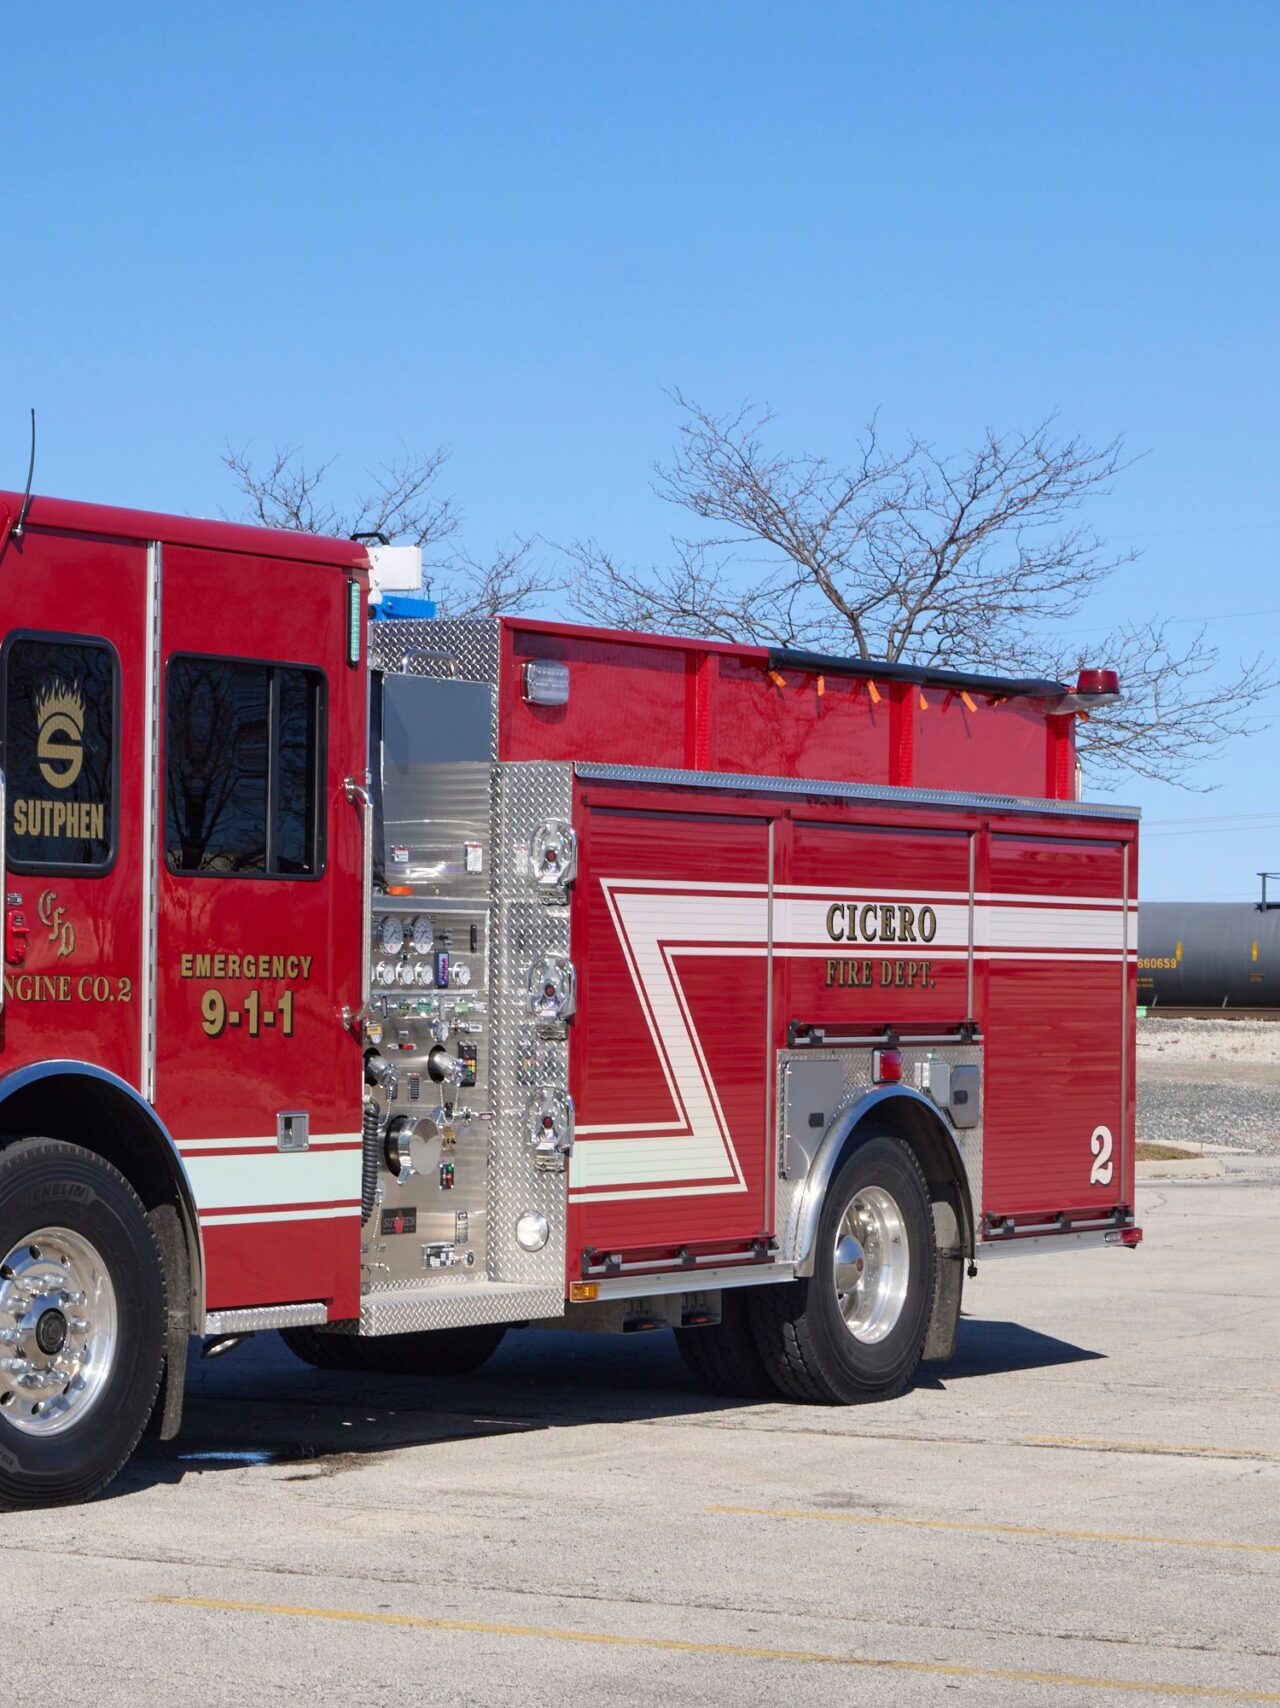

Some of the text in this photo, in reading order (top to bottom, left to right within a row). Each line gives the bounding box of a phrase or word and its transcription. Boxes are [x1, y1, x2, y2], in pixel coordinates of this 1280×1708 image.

[13, 799, 104, 839] SUTPHEN
[826, 903, 937, 943] CICERO
[181, 954, 313, 979] EMERGENCY
[825, 960, 936, 989] FIRE DEPT.
[1137, 958, 1177, 969] 660659
[78, 976, 115, 1002] CO.
[118, 976, 133, 1002] 2
[201, 988, 295, 1039] 9-1-1
[1090, 1124, 1114, 1186] 2
